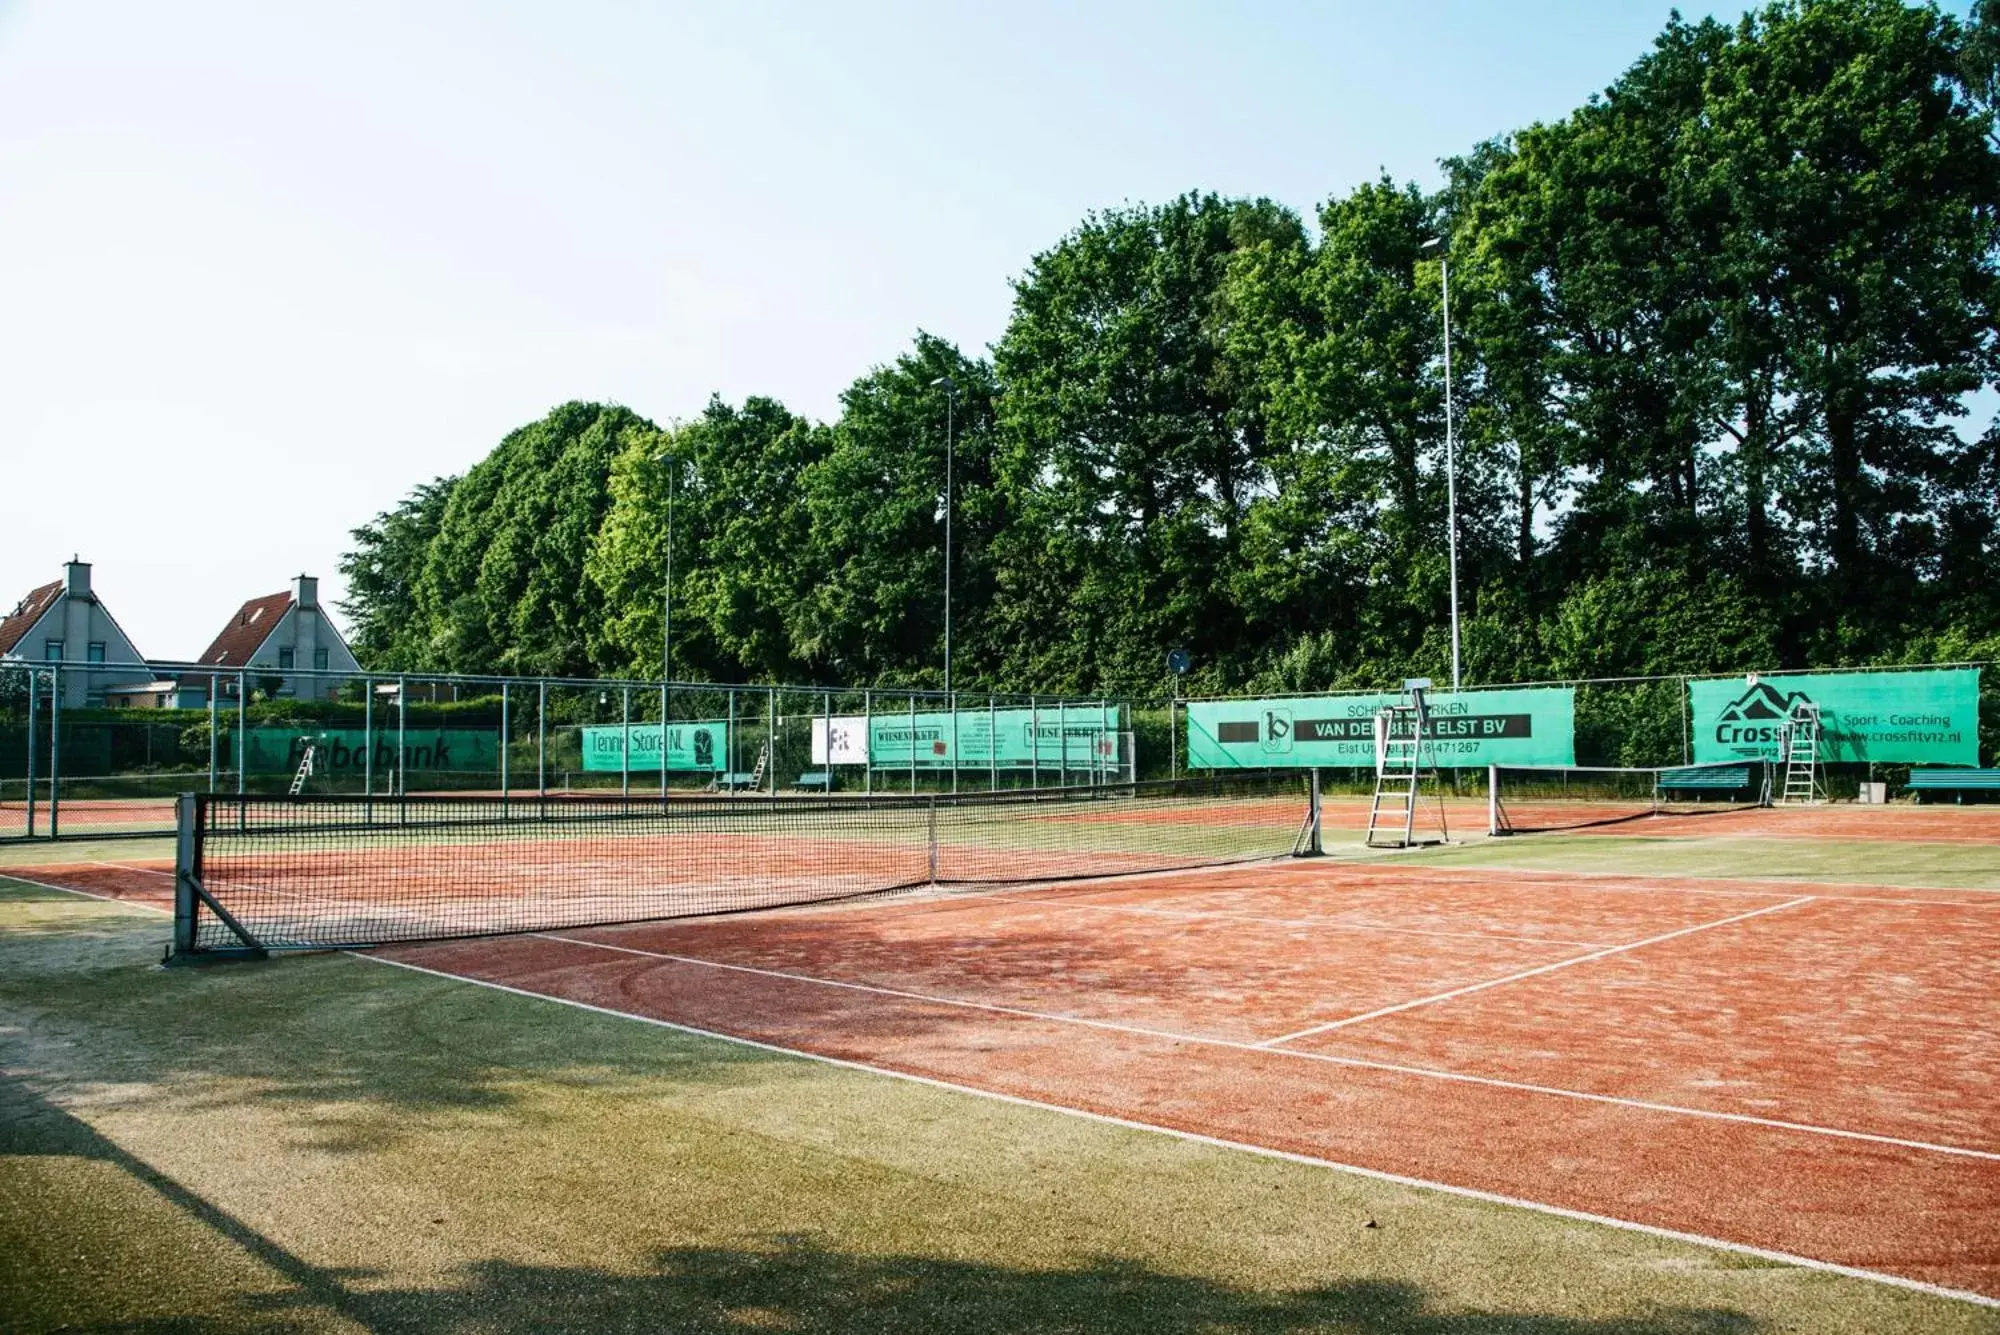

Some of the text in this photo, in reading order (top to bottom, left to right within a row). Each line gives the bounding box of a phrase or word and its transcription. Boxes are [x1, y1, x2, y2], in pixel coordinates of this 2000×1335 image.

[1315, 722, 1344, 737] VAN
[1436, 720, 1478, 735] ELST
[1483, 719, 1506, 734] BV
[1843, 714, 1877, 728] Sport
[1889, 713, 1951, 728] Coaching
[590, 731, 625, 752] Tenni
[631, 729, 664, 752] Store
[877, 730, 940, 742] WIESENKKER
[1338, 743, 1359, 754] Elst
